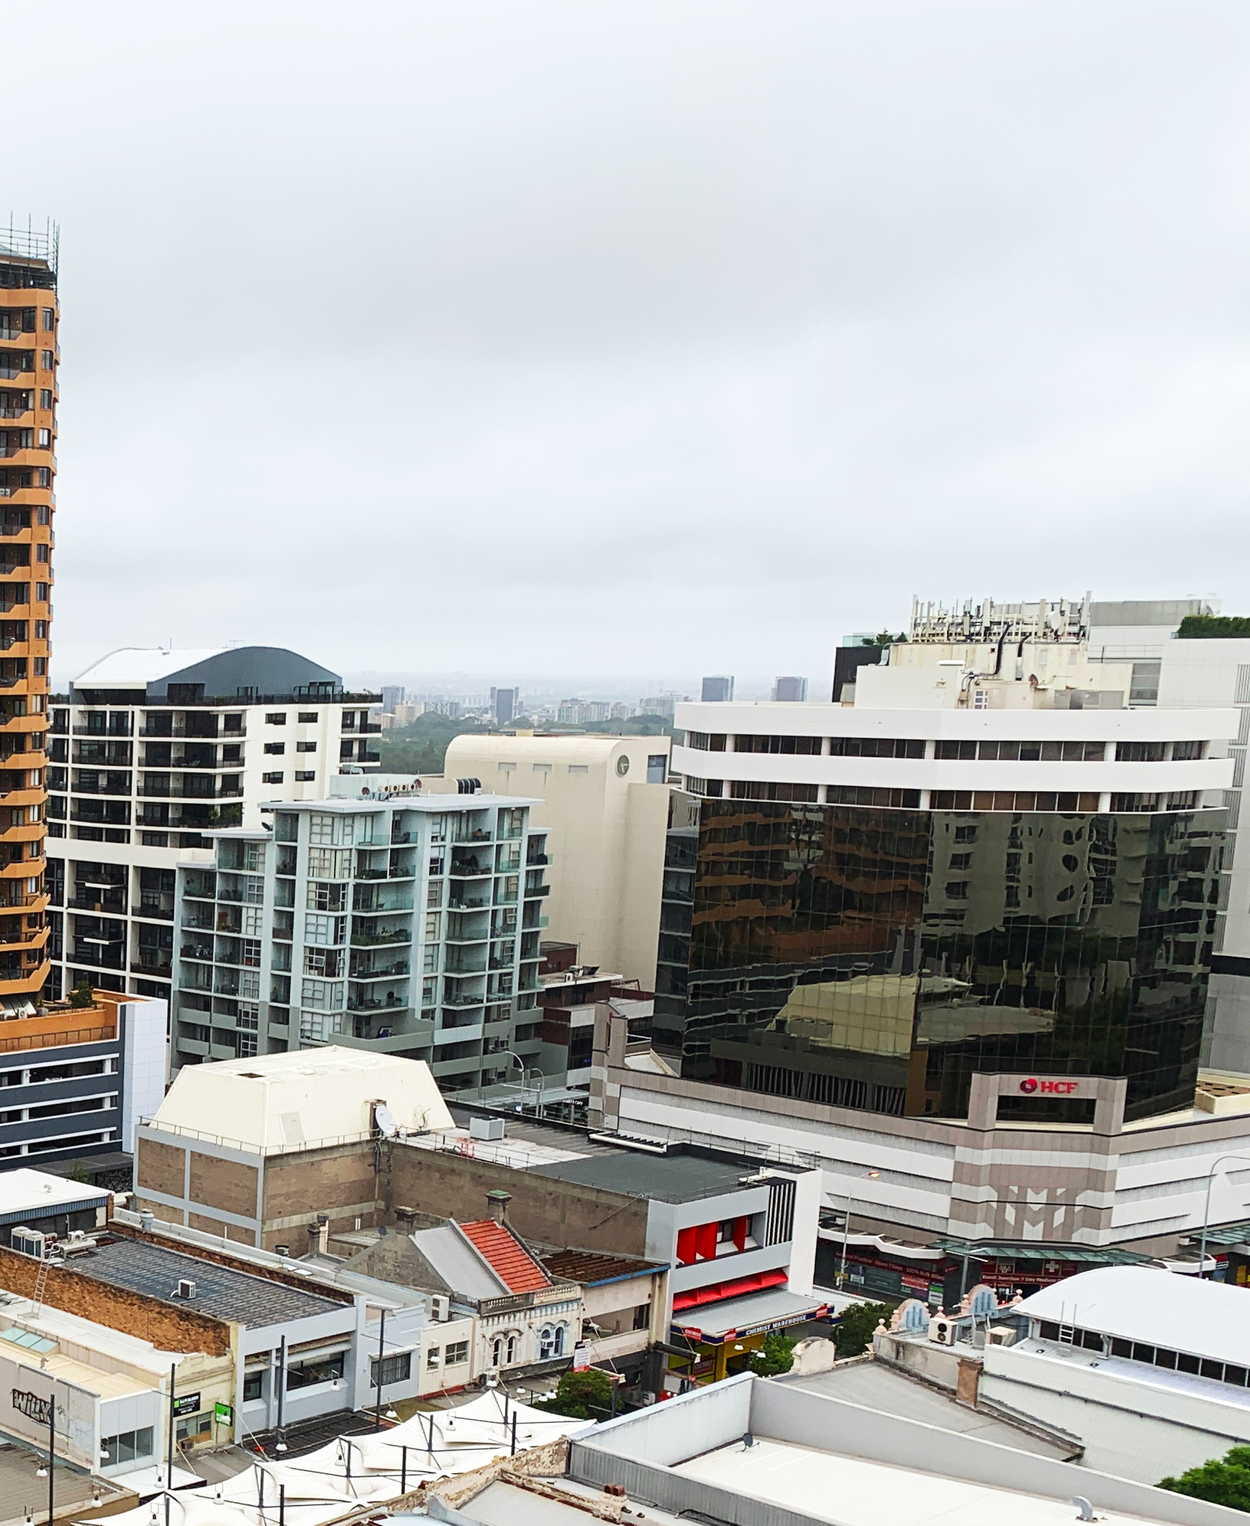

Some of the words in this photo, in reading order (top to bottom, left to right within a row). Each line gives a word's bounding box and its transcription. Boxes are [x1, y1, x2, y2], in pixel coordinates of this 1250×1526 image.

[1040, 1081, 1078, 1094] HCF
[745, 1323, 771, 1336] CHEMIST
[772, 1314, 807, 1329] WAREHOUSE
